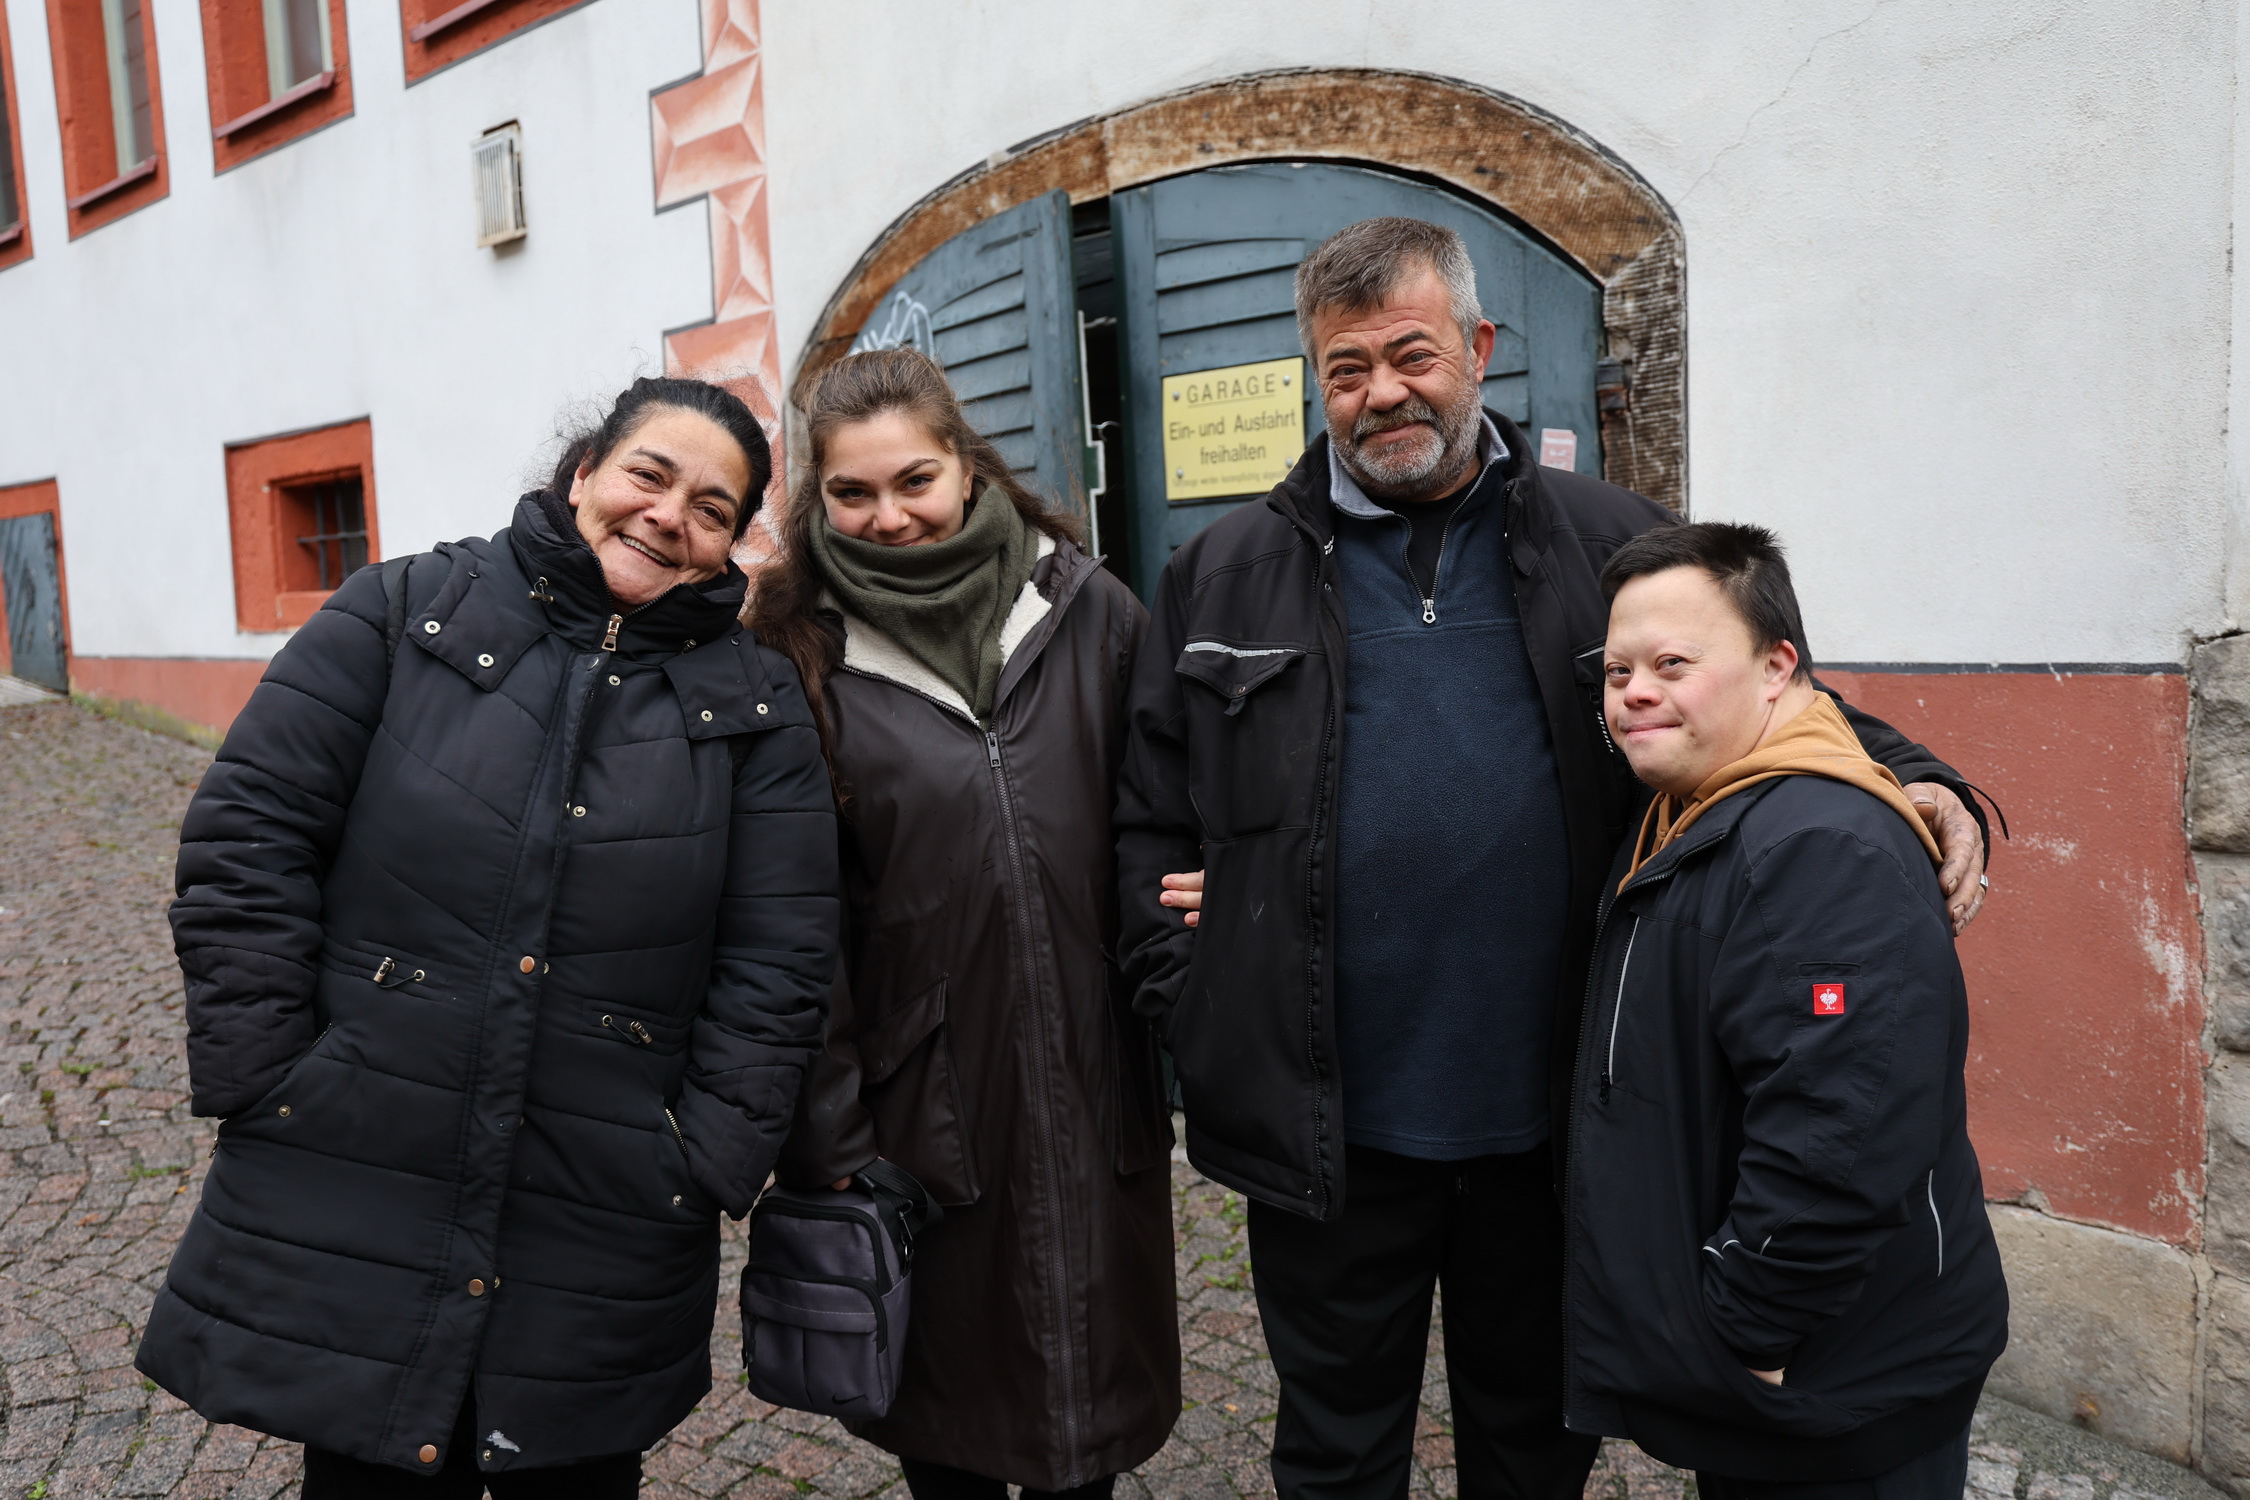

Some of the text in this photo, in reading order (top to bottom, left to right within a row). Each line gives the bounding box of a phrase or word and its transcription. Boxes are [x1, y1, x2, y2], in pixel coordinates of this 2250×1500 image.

[1186, 373, 1276, 404] GARAGE
[1169, 408, 1297, 441] Ein- und Ausfahrt
[1200, 443, 1267, 465] freihalten
